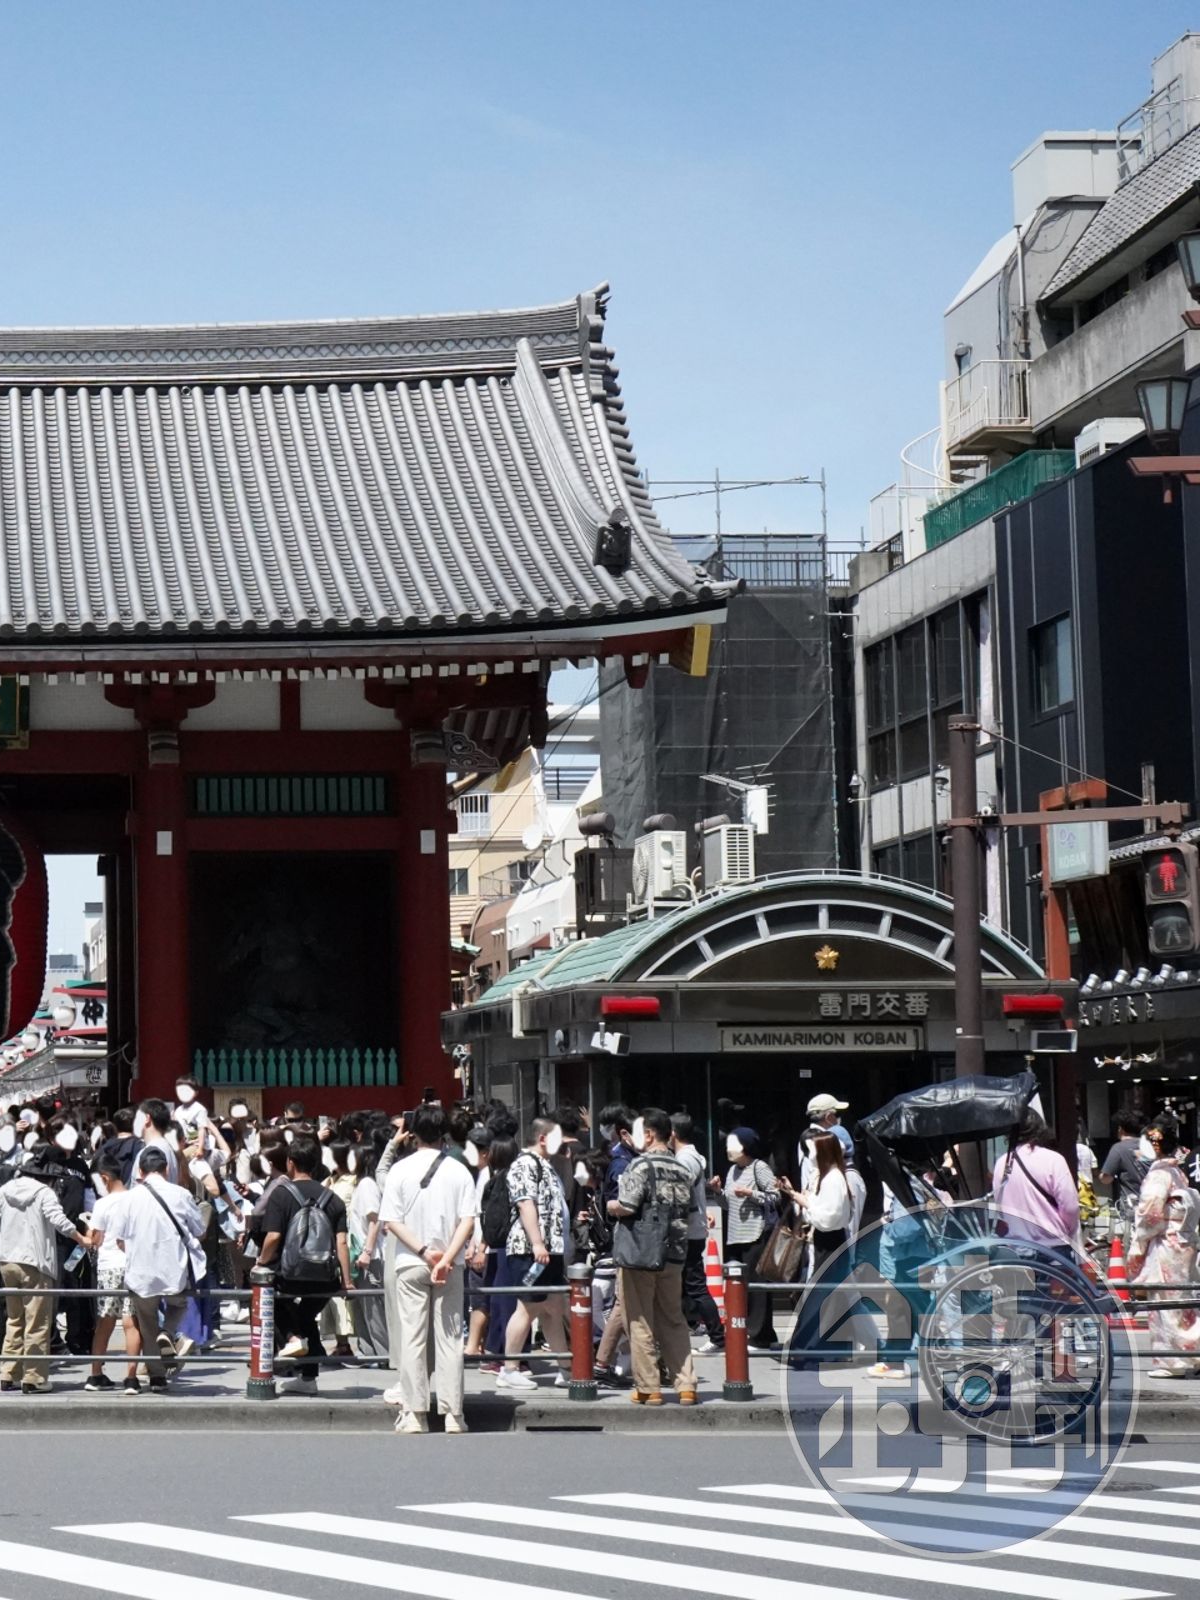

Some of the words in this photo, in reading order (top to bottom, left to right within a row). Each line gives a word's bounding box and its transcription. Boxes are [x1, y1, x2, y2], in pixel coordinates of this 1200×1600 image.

[818, 992, 930, 1017] 雷門交番
[732, 1032, 845, 1046] KAMINARIMON
[853, 1032, 907, 1045] KOBAN
